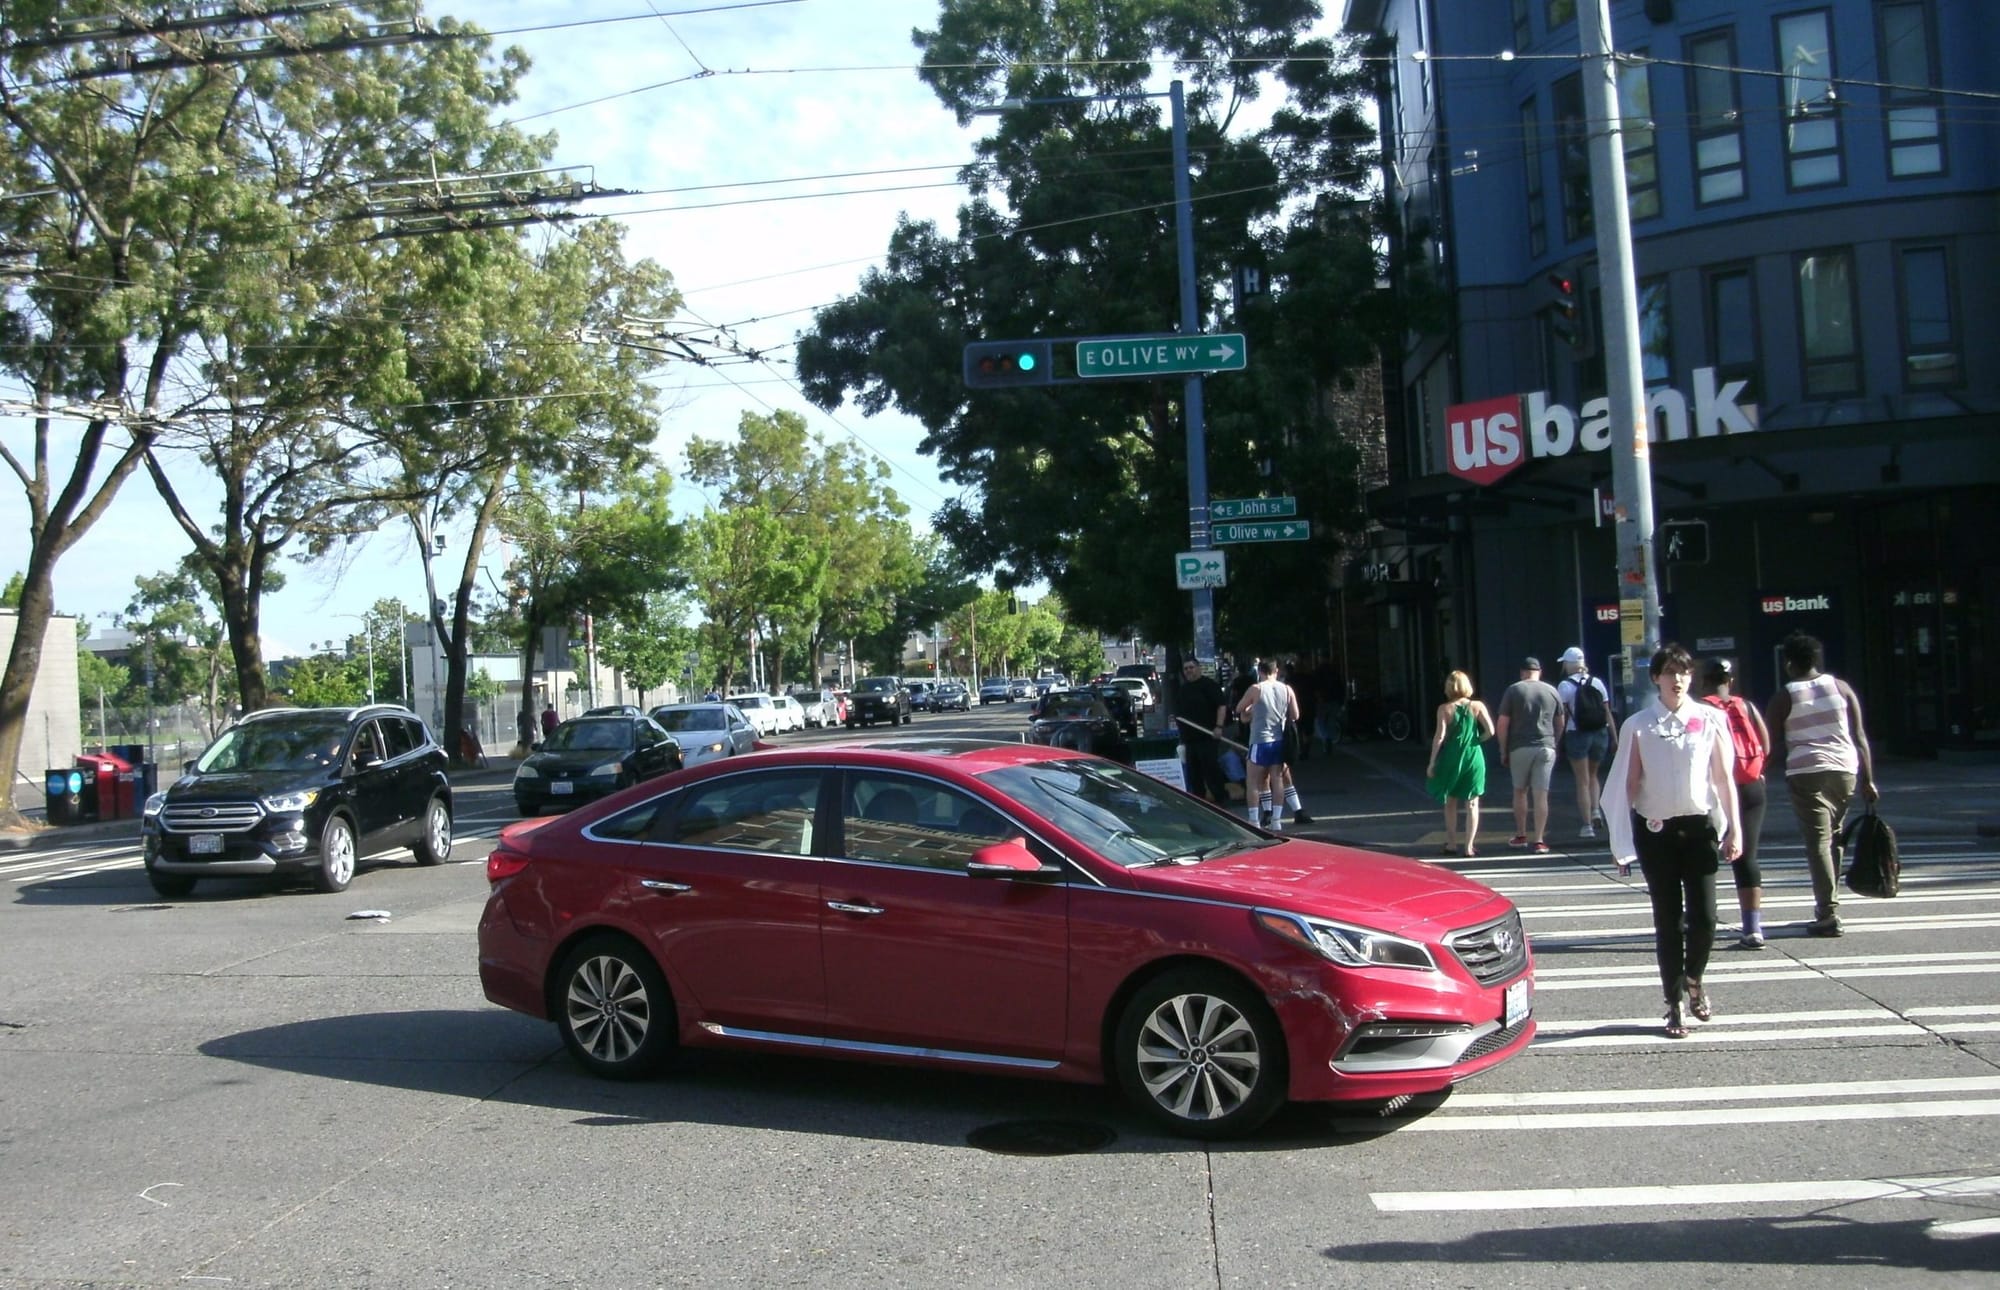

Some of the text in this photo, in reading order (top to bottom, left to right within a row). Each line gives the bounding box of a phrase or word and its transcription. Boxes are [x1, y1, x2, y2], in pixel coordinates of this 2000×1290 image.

[1086, 346, 1199, 366] E OLIVE WY
[1226, 502, 1281, 516] E John St
[1215, 525, 1278, 540] E Olive Wy
